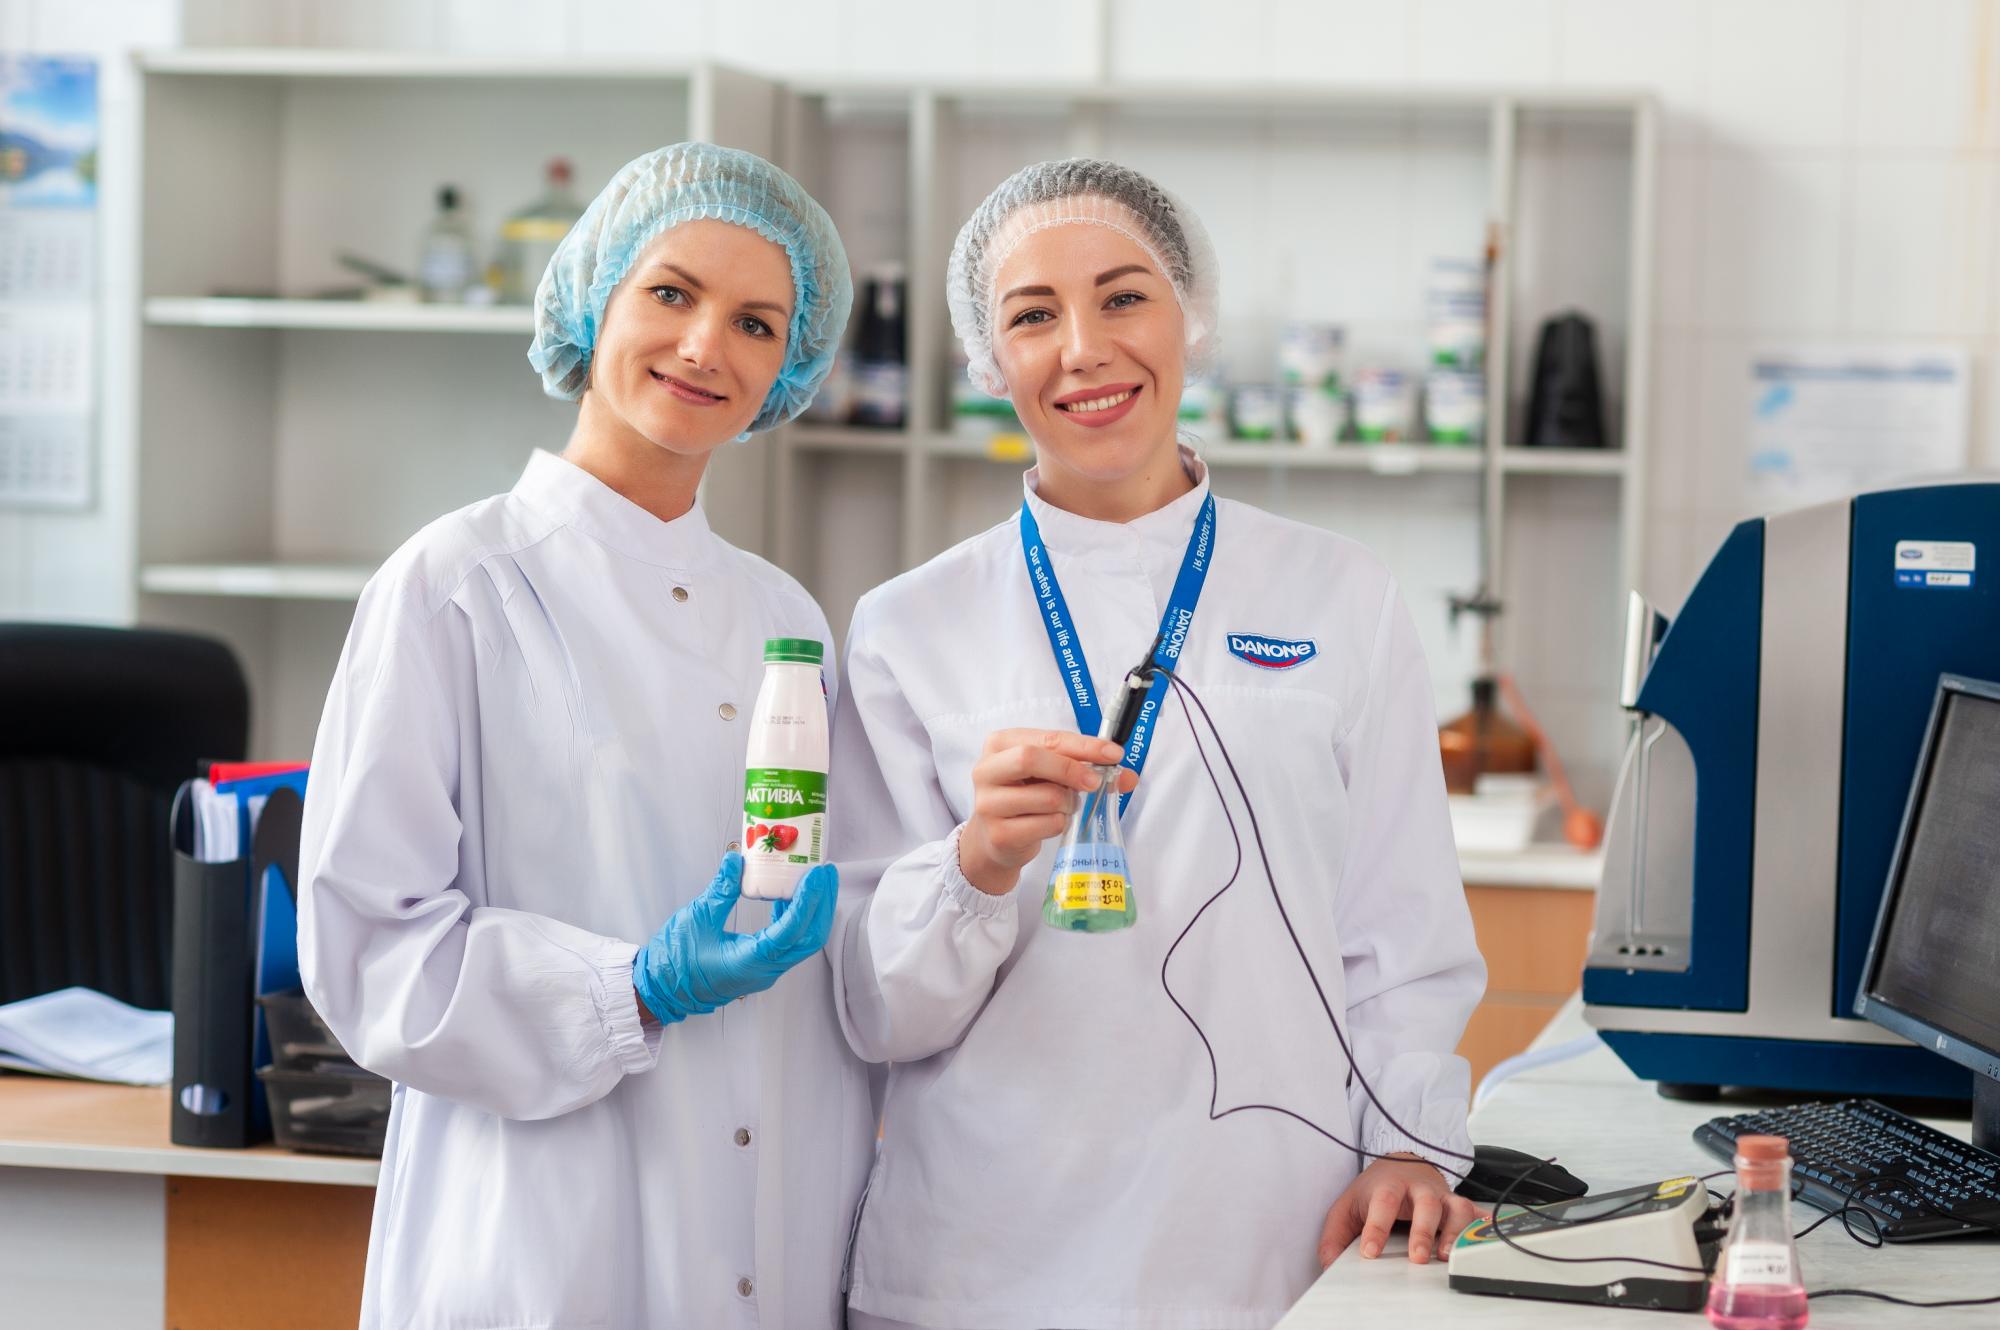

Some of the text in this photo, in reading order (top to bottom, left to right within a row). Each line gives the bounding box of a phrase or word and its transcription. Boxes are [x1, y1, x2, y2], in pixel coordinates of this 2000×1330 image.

[1192, 521, 1211, 573] здоров'я!
[1029, 545, 1091, 707] Our safety is our life and health!
[1165, 608, 1193, 659] DANONE
[1231, 636, 1312, 658] DANONE
[1126, 700, 1156, 767] Our safety
